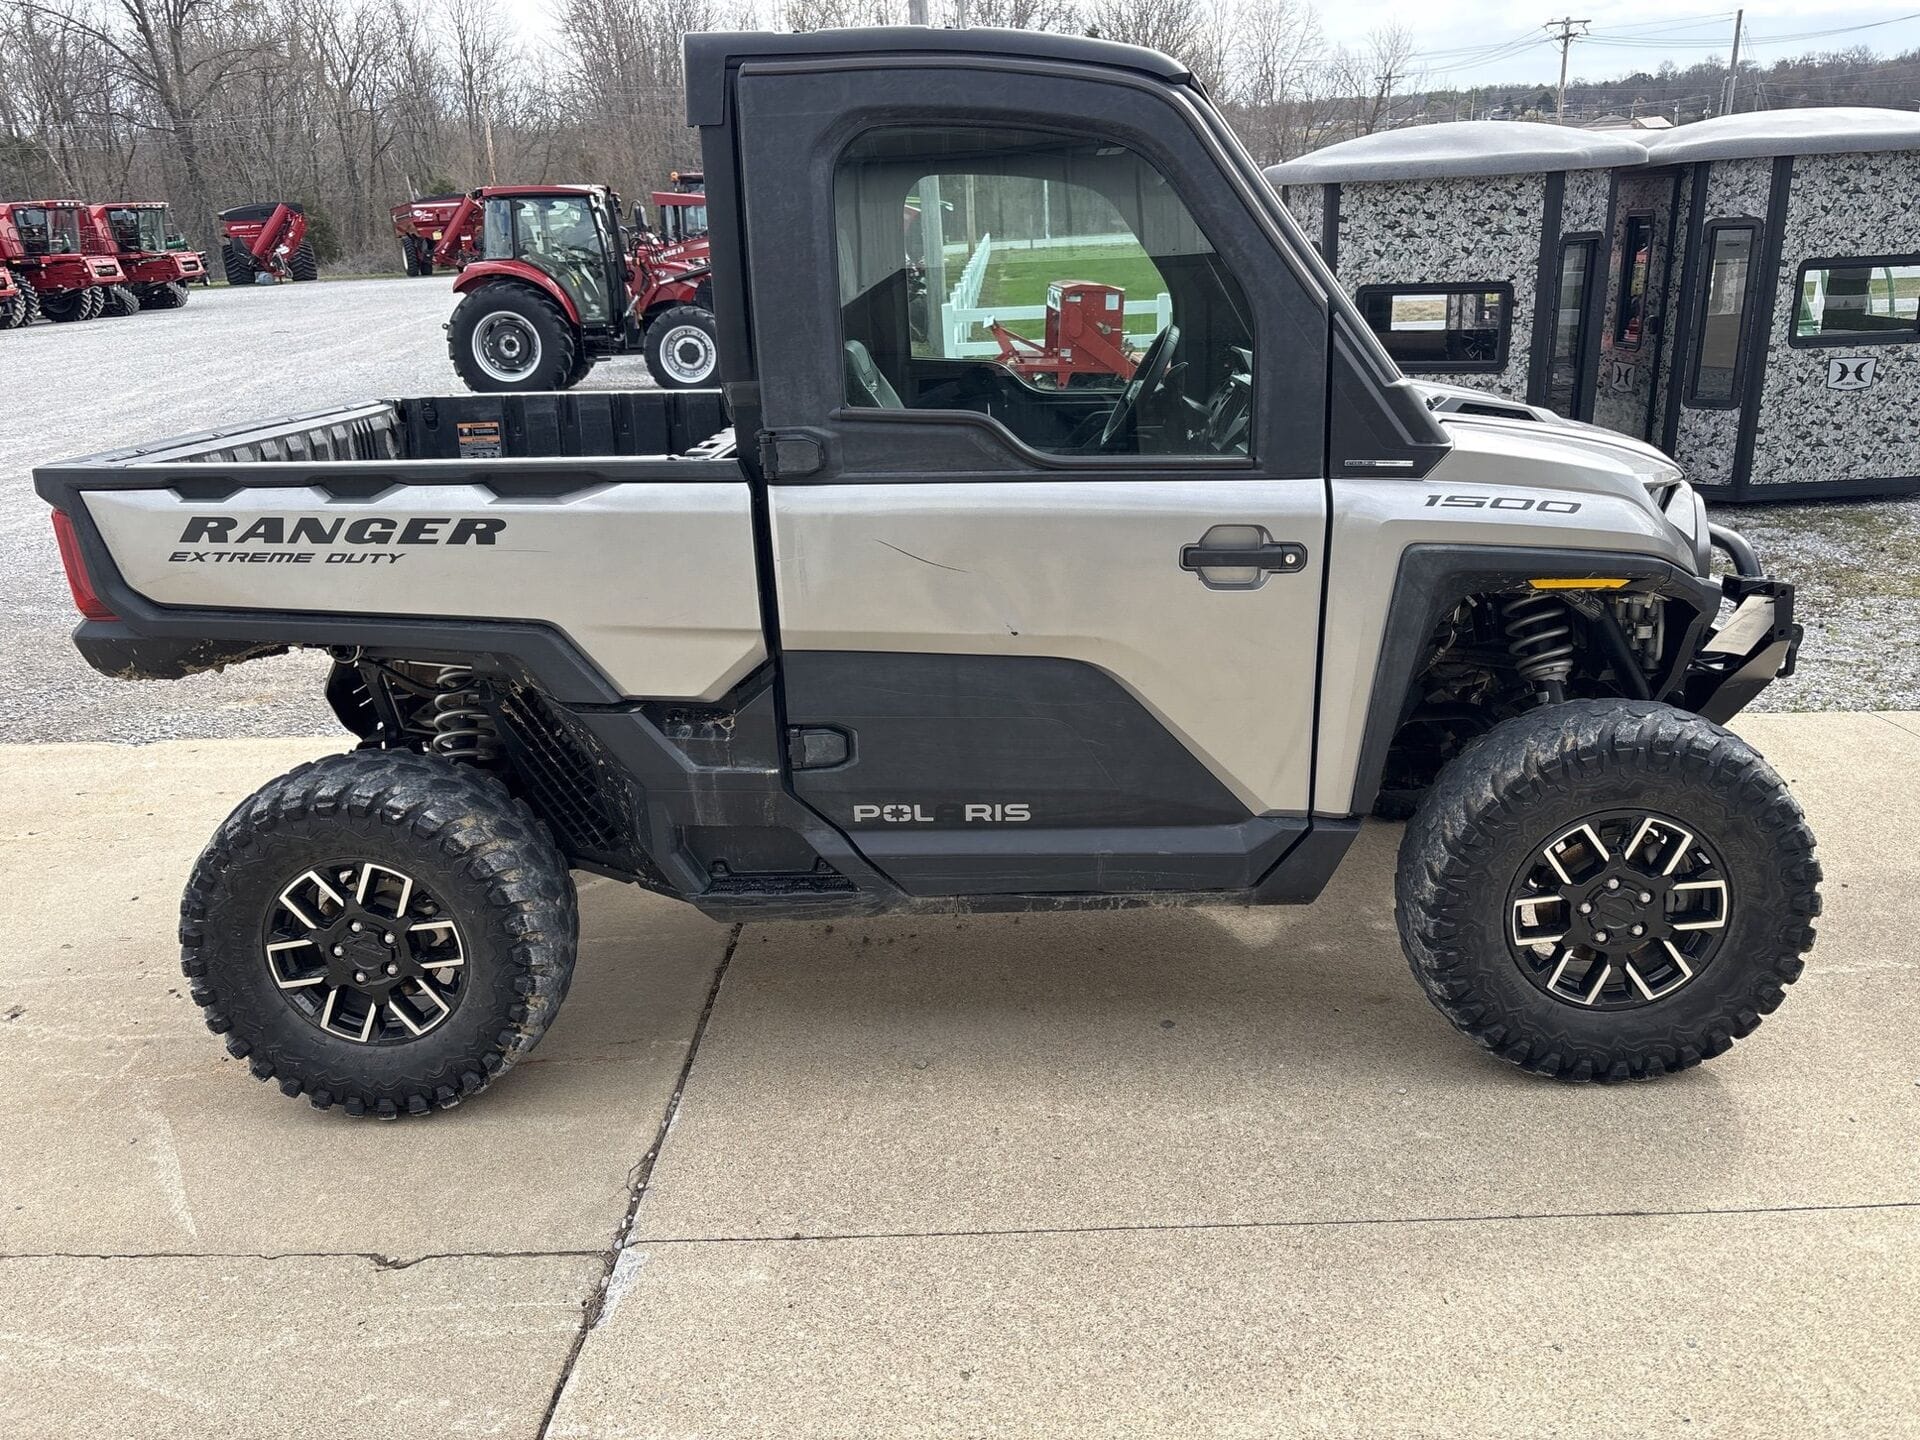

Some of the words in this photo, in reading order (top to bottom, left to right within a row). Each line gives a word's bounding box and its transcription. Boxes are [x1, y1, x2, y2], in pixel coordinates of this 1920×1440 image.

[1424, 494, 1582, 514] 1500
[179, 516, 507, 545] RANGER
[168, 551, 316, 563] EXTREME
[325, 553, 407, 565] DUTY
[853, 804, 1031, 822] POLRIS
